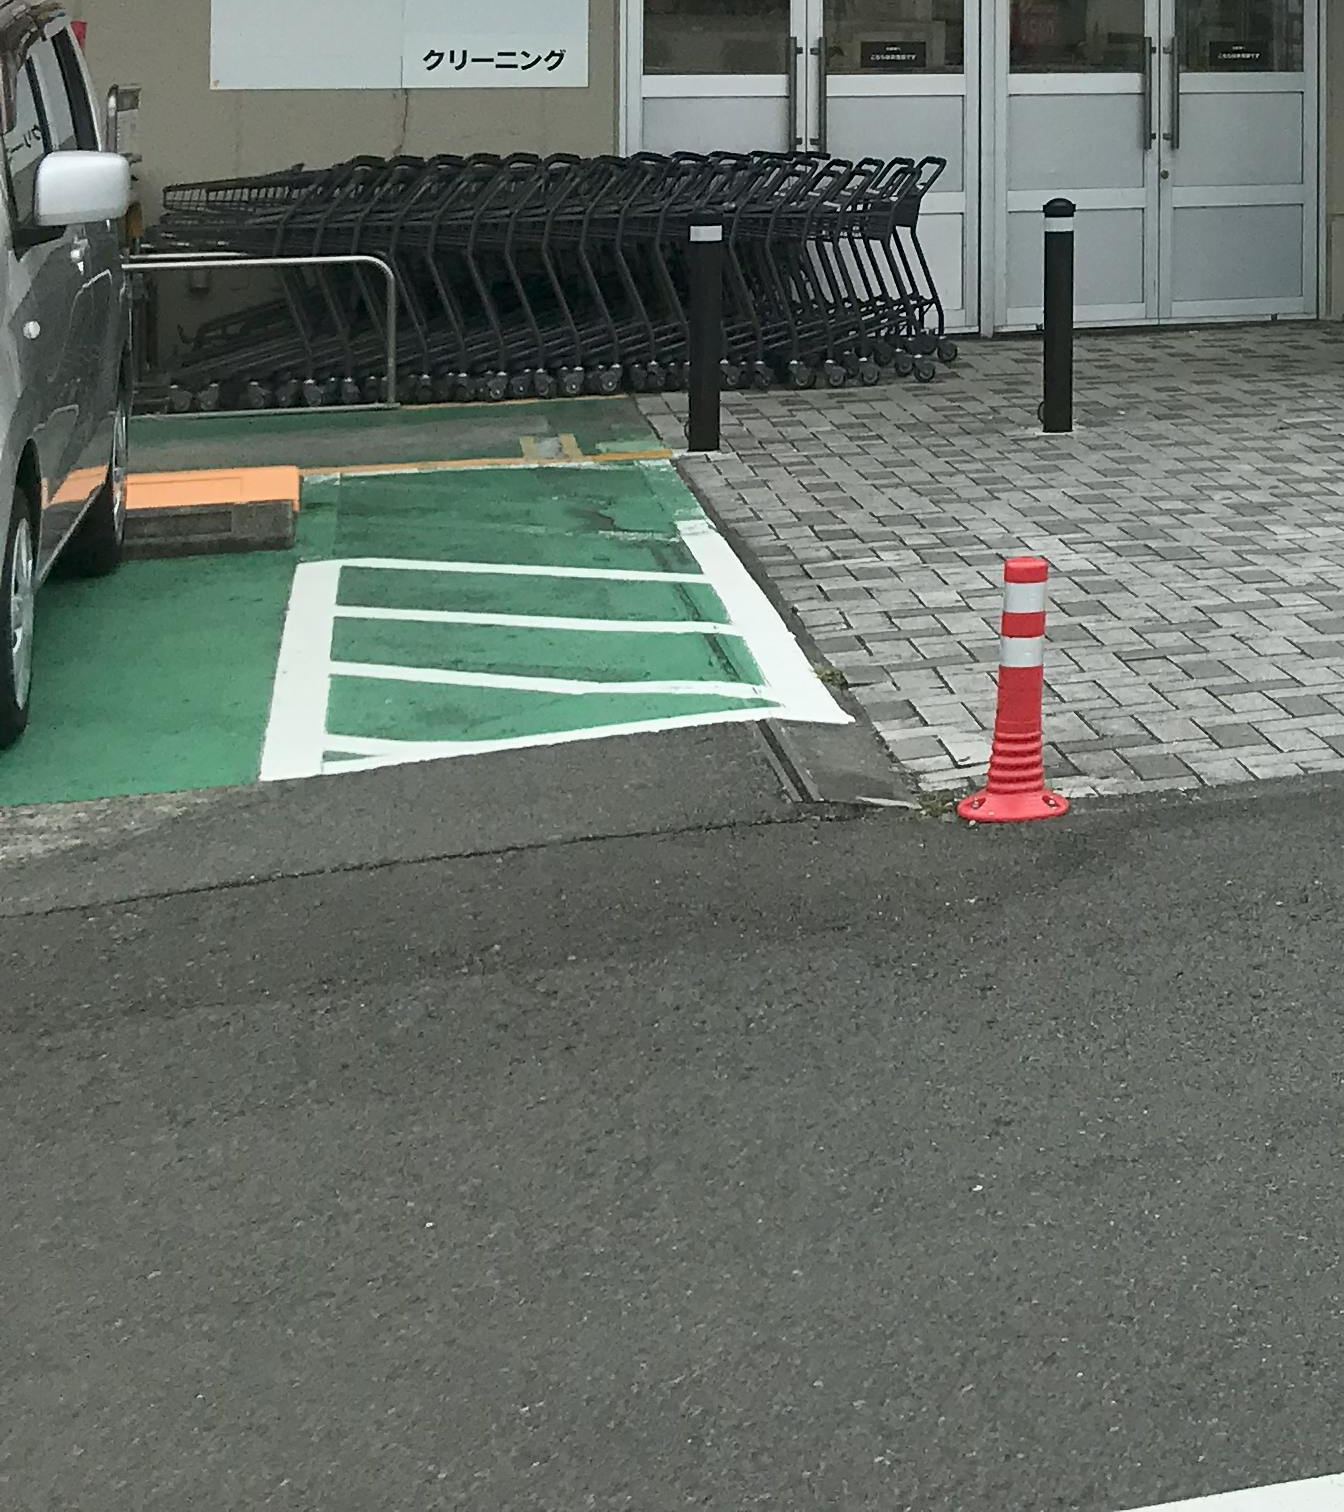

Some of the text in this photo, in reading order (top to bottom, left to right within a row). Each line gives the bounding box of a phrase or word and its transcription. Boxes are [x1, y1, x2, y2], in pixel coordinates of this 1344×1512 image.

[422, 48, 568, 72] クリーニング
